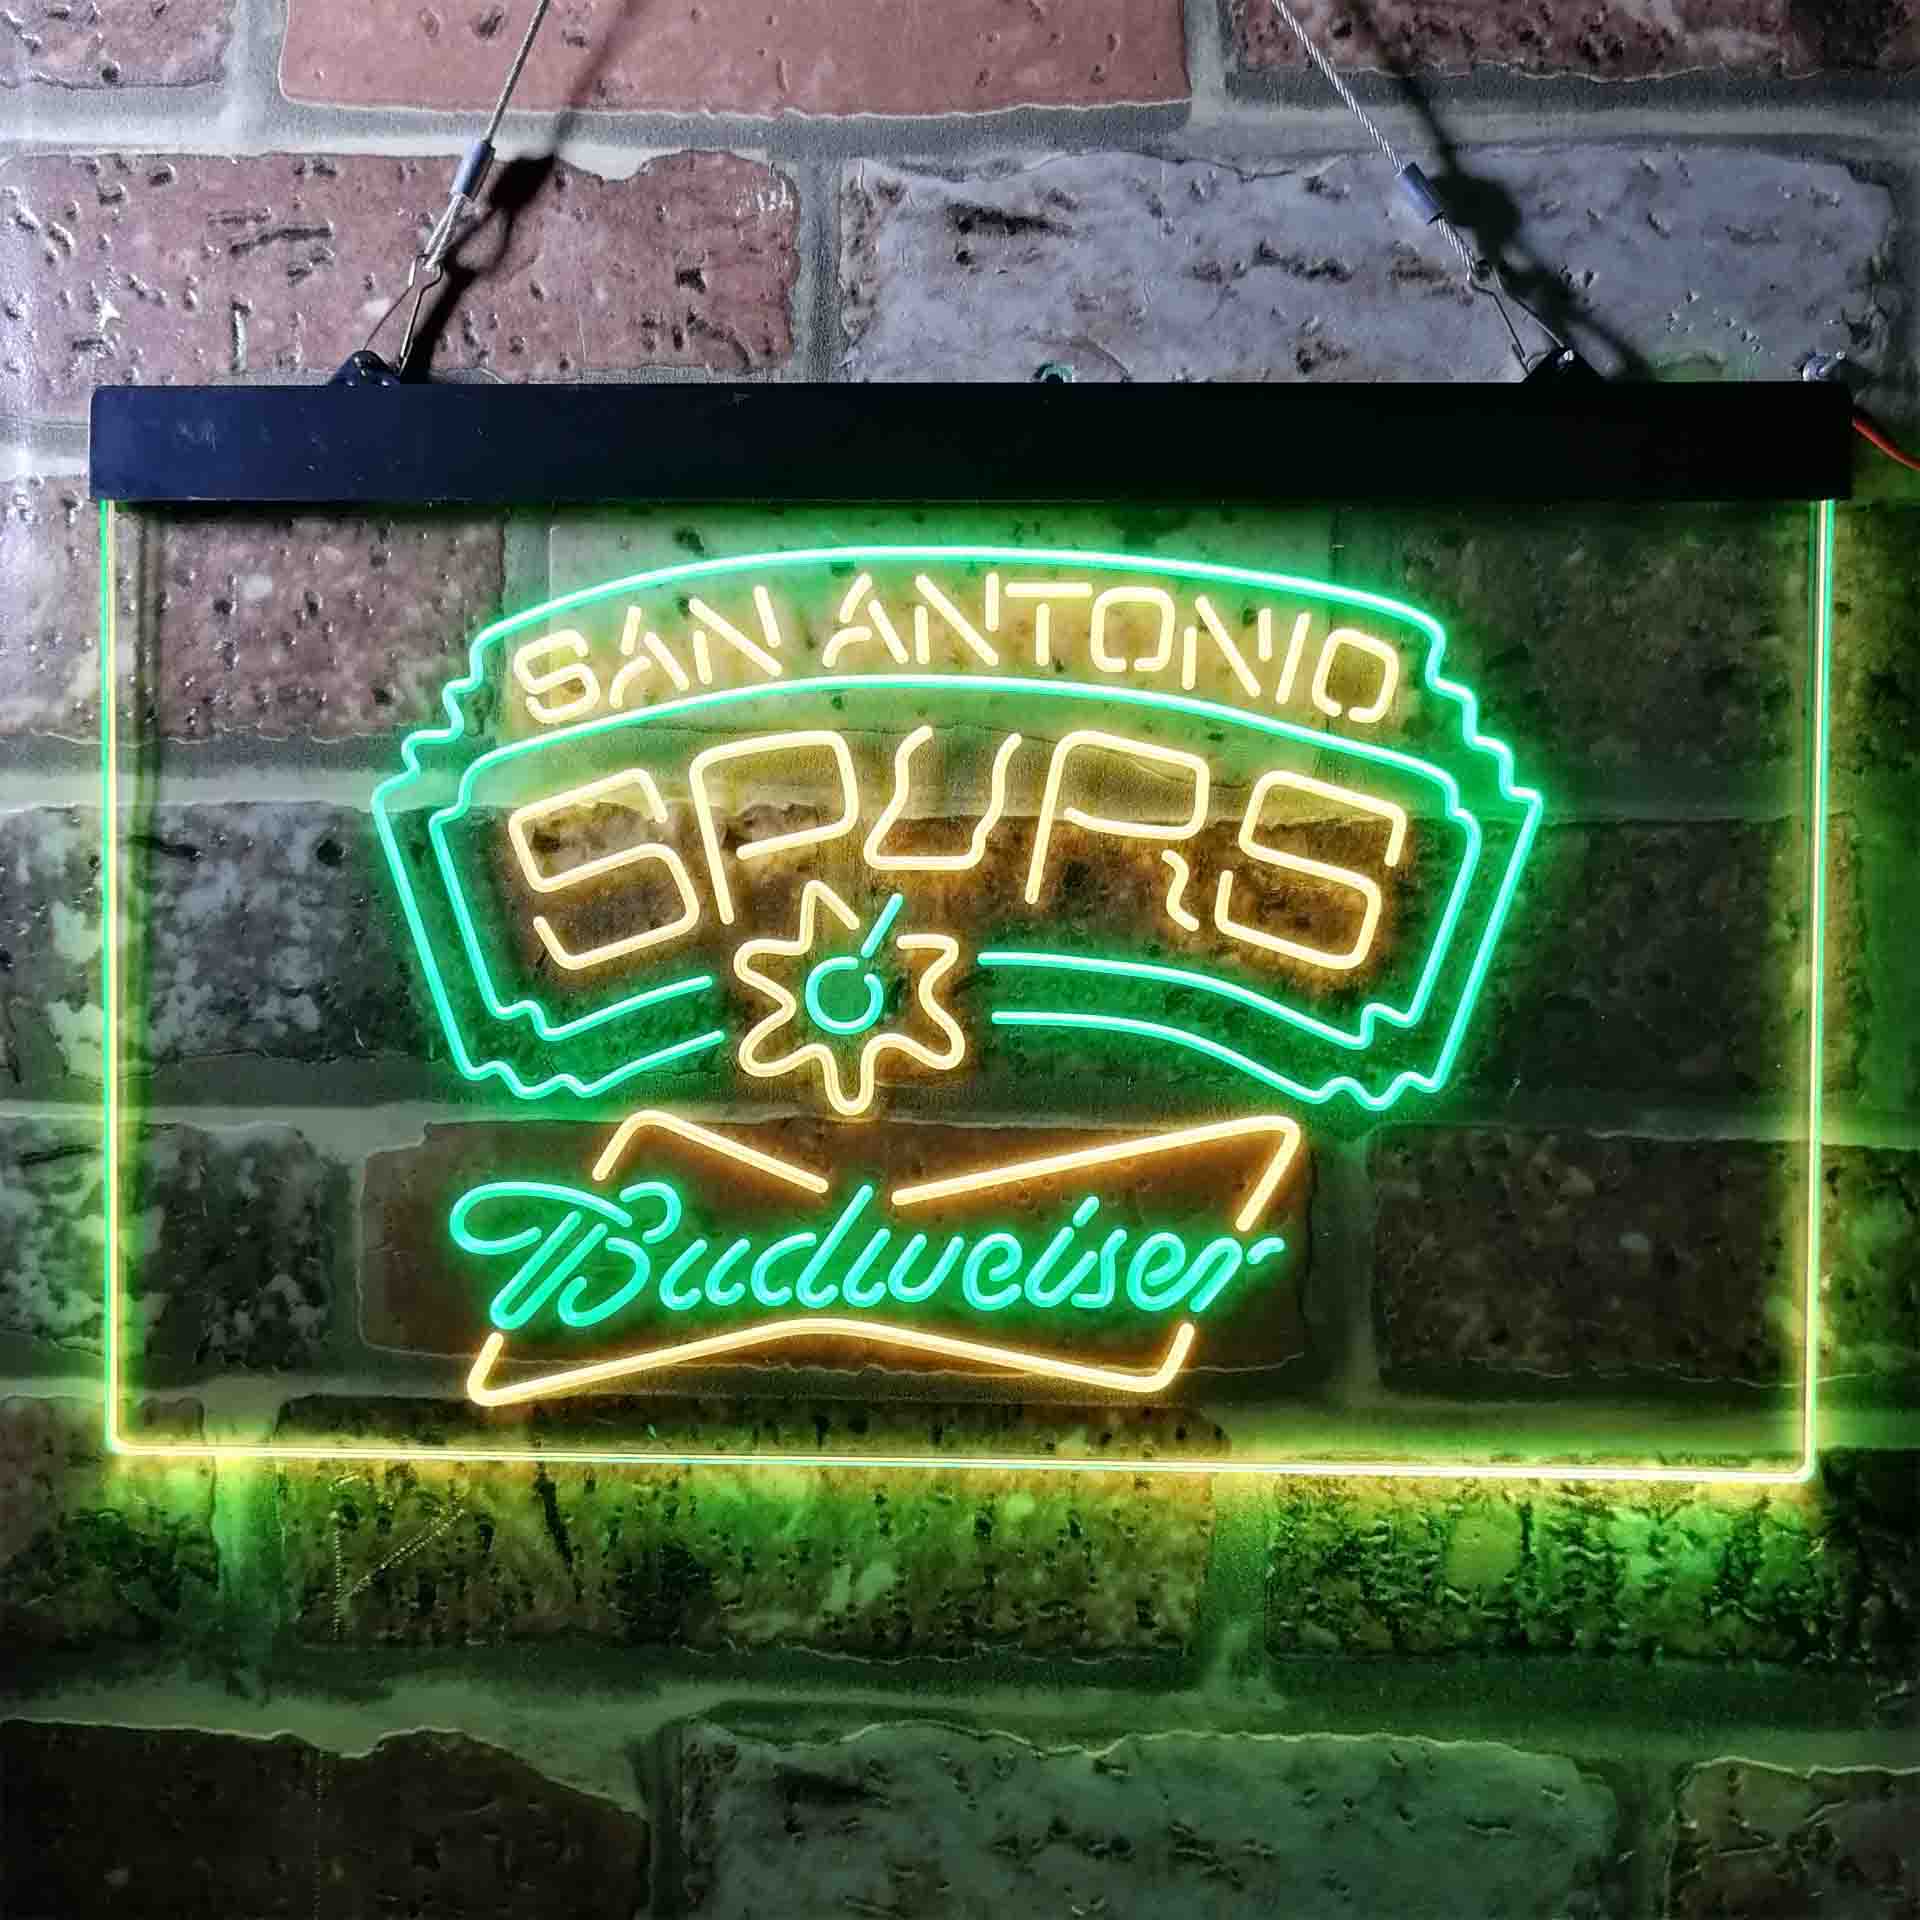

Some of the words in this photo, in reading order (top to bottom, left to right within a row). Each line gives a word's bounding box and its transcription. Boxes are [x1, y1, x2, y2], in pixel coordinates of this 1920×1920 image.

[513, 585, 784, 725] SAN
[822, 572, 1401, 724] ANTONIO
[508, 727, 1407, 971] SPURS
[449, 1181, 1286, 1331] Budweiser
